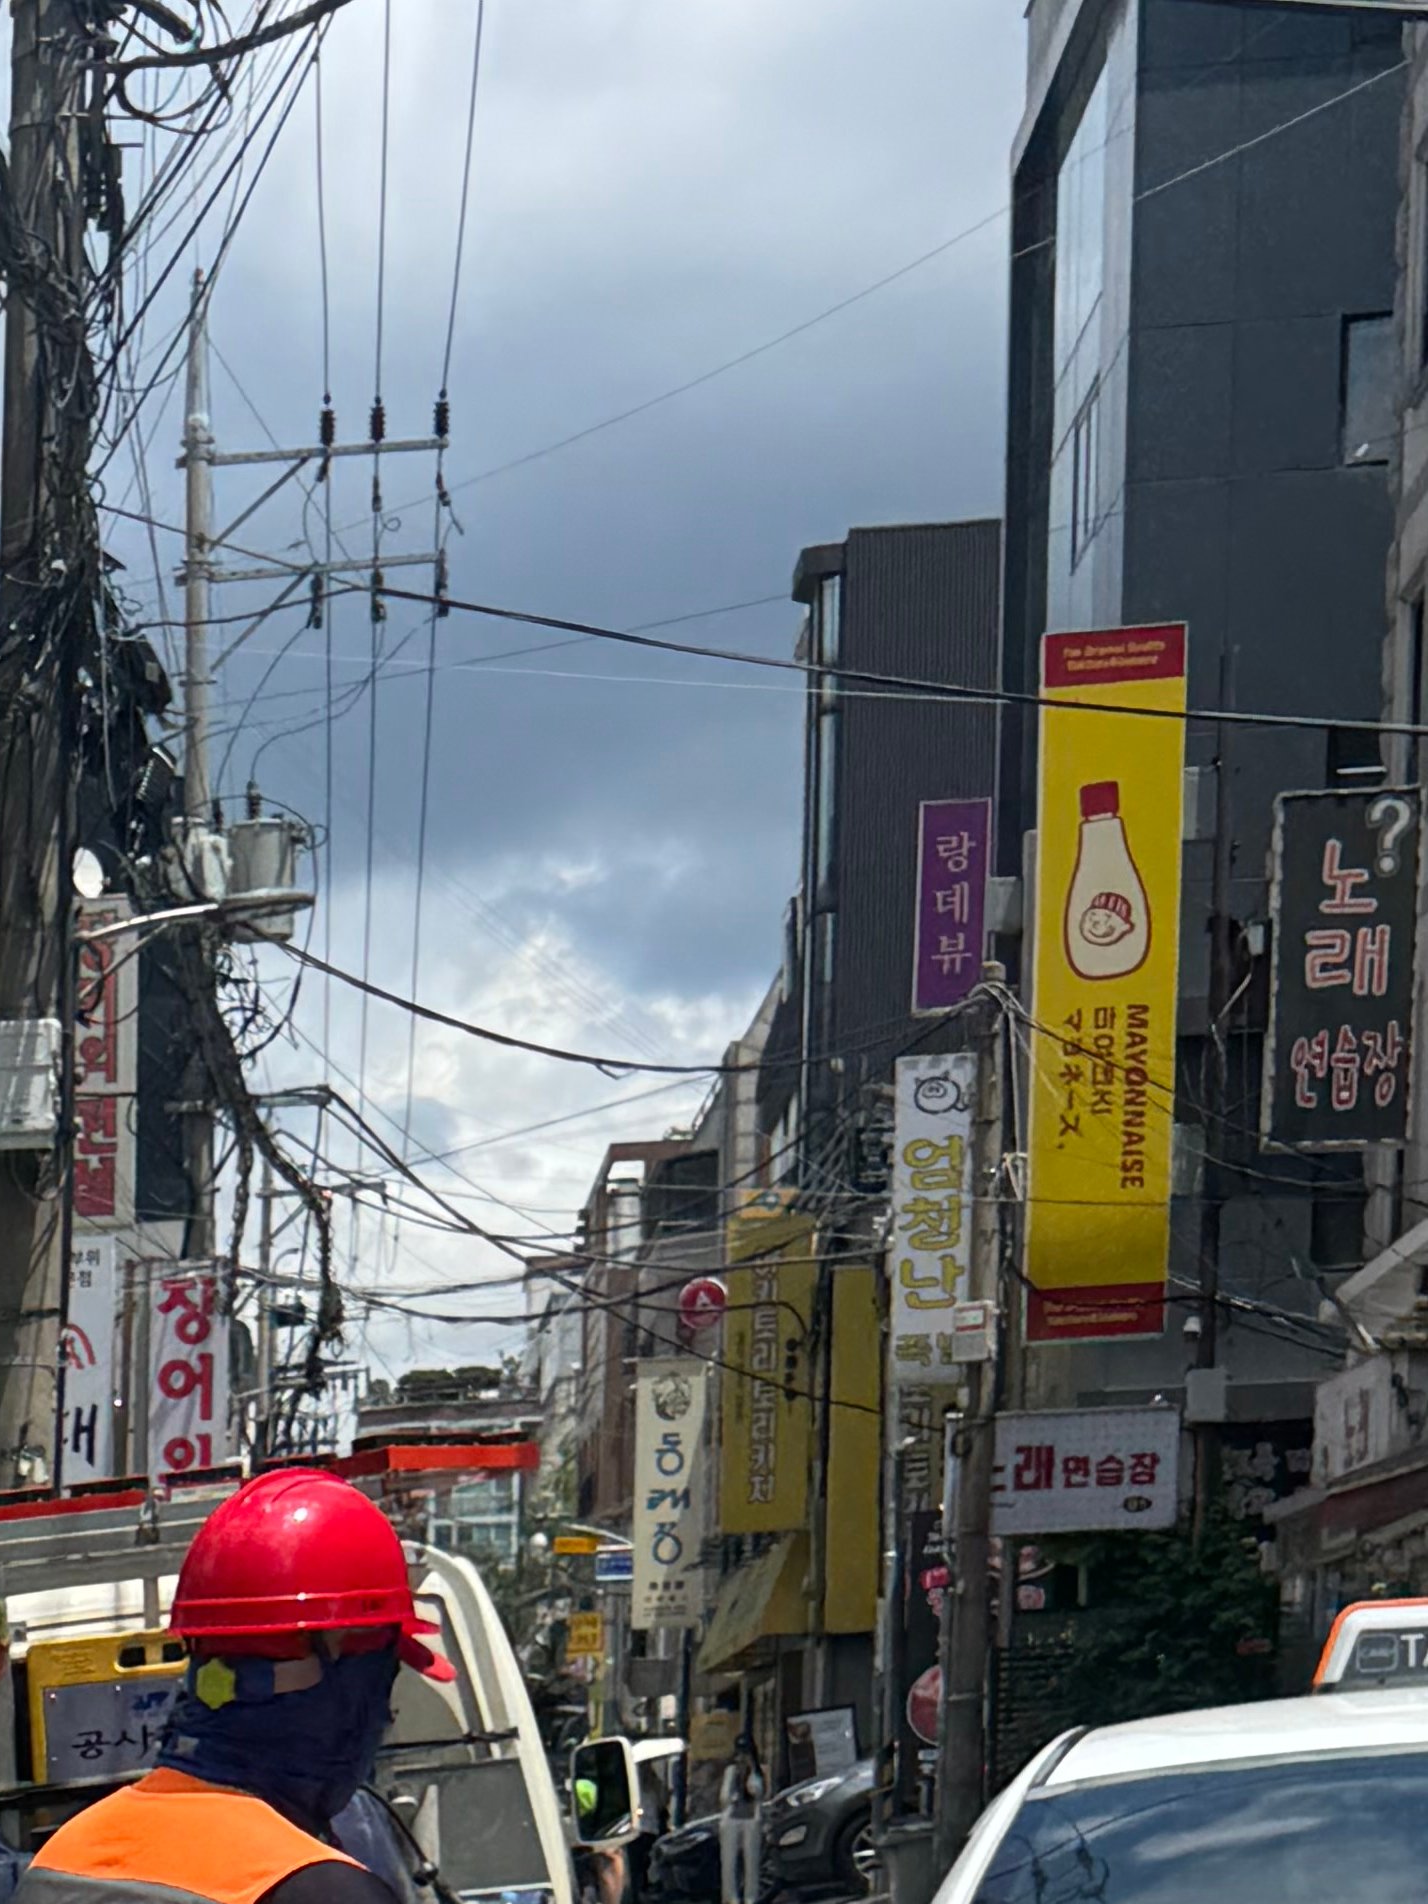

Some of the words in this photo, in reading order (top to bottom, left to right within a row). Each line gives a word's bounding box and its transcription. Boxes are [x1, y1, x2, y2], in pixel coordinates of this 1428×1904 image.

[930, 831, 976, 975] 랑데뷰
[1119, 1003, 1150, 1190] MAYONNAISE
[1291, 1020, 1402, 1111] 연습장
[1400, 1632, 1428, 1669] T
[71, 1723, 156, 1761] 공사
